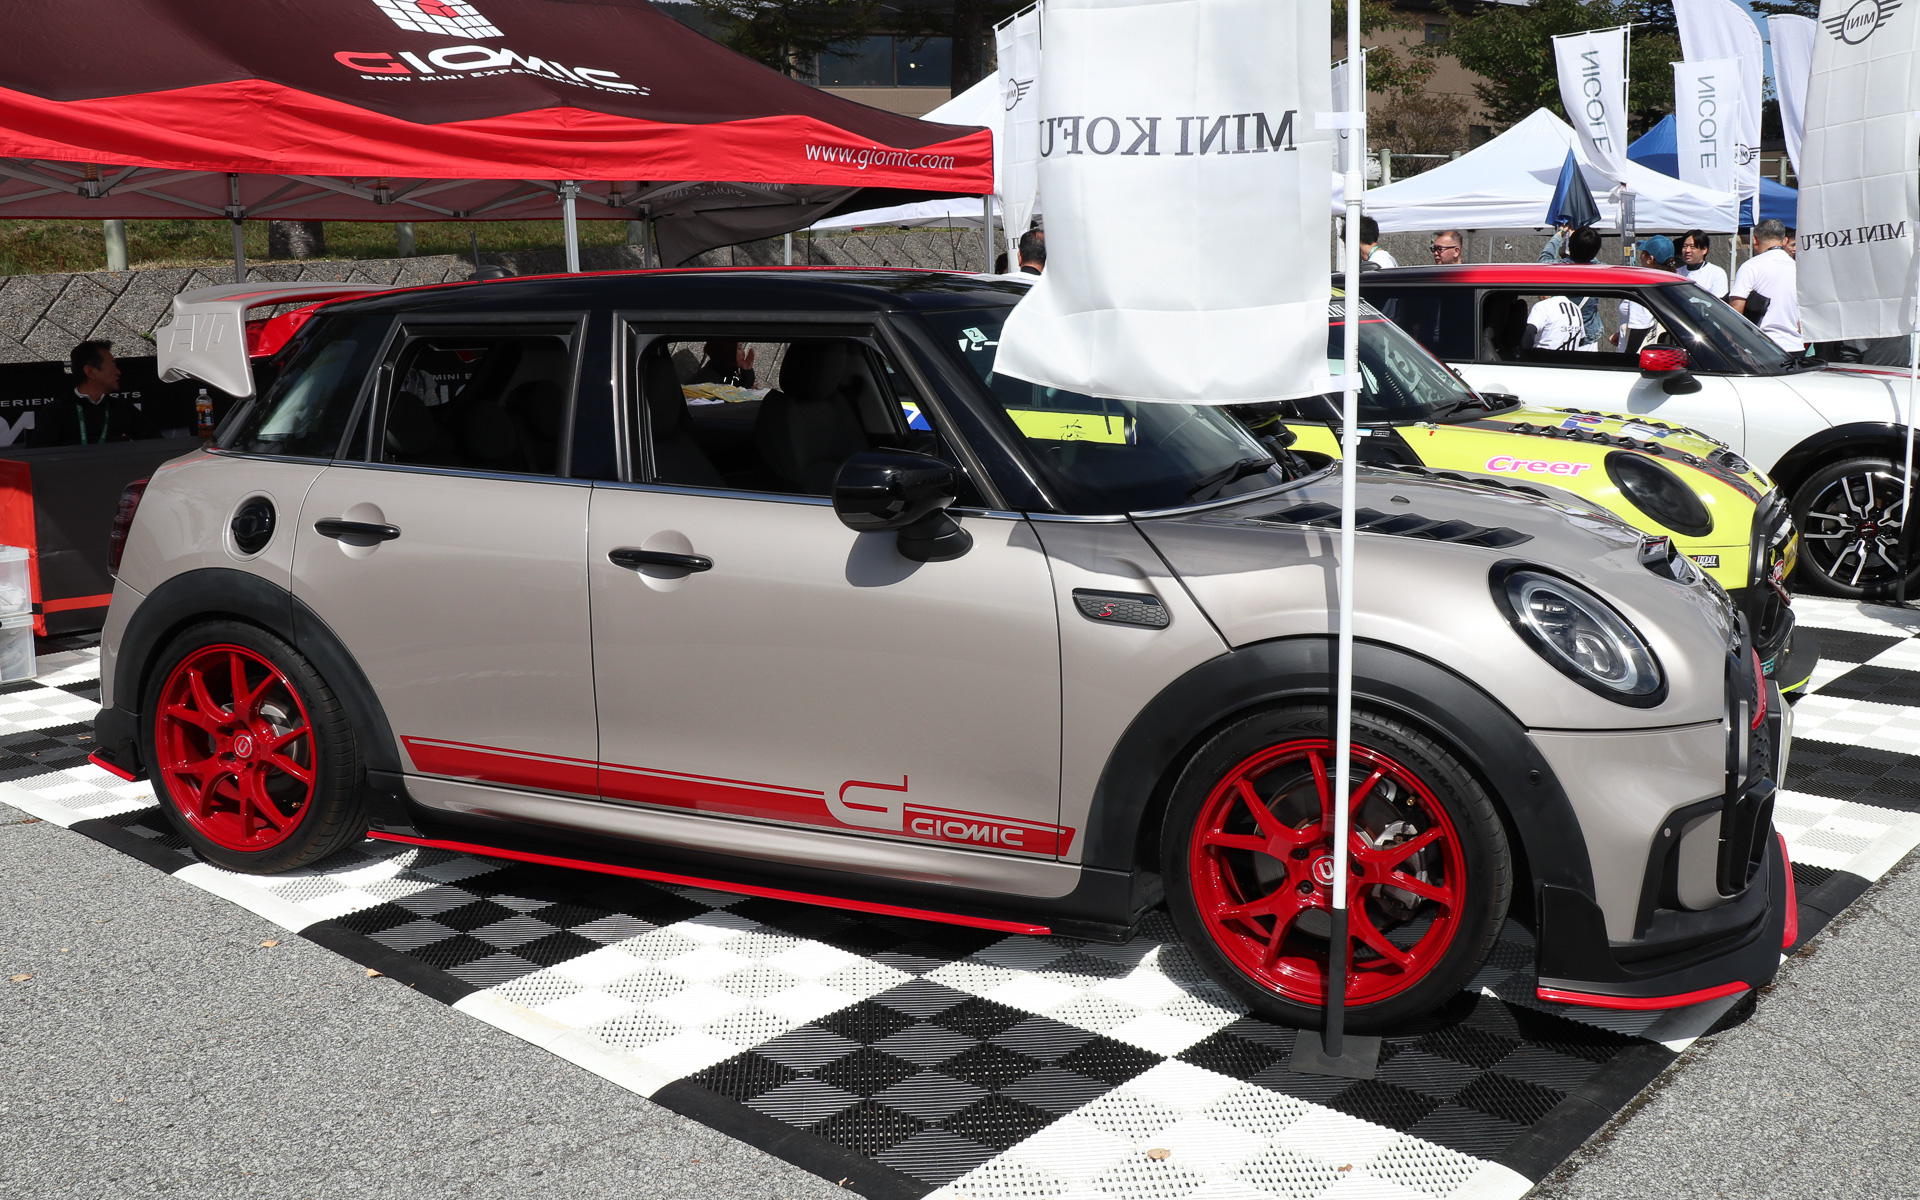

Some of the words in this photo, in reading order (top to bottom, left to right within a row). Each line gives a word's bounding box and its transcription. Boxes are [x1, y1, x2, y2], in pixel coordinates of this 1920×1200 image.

[333, 45, 640, 91] GIOMIC
[360, 74, 412, 82] BMW
[418, 74, 465, 82] MINI
[805, 143, 955, 170] www.giomic.com
[1486, 456, 1589, 475] Creer
[1098, 603, 1115, 617] S
[910, 817, 1024, 847] GIOMIC
